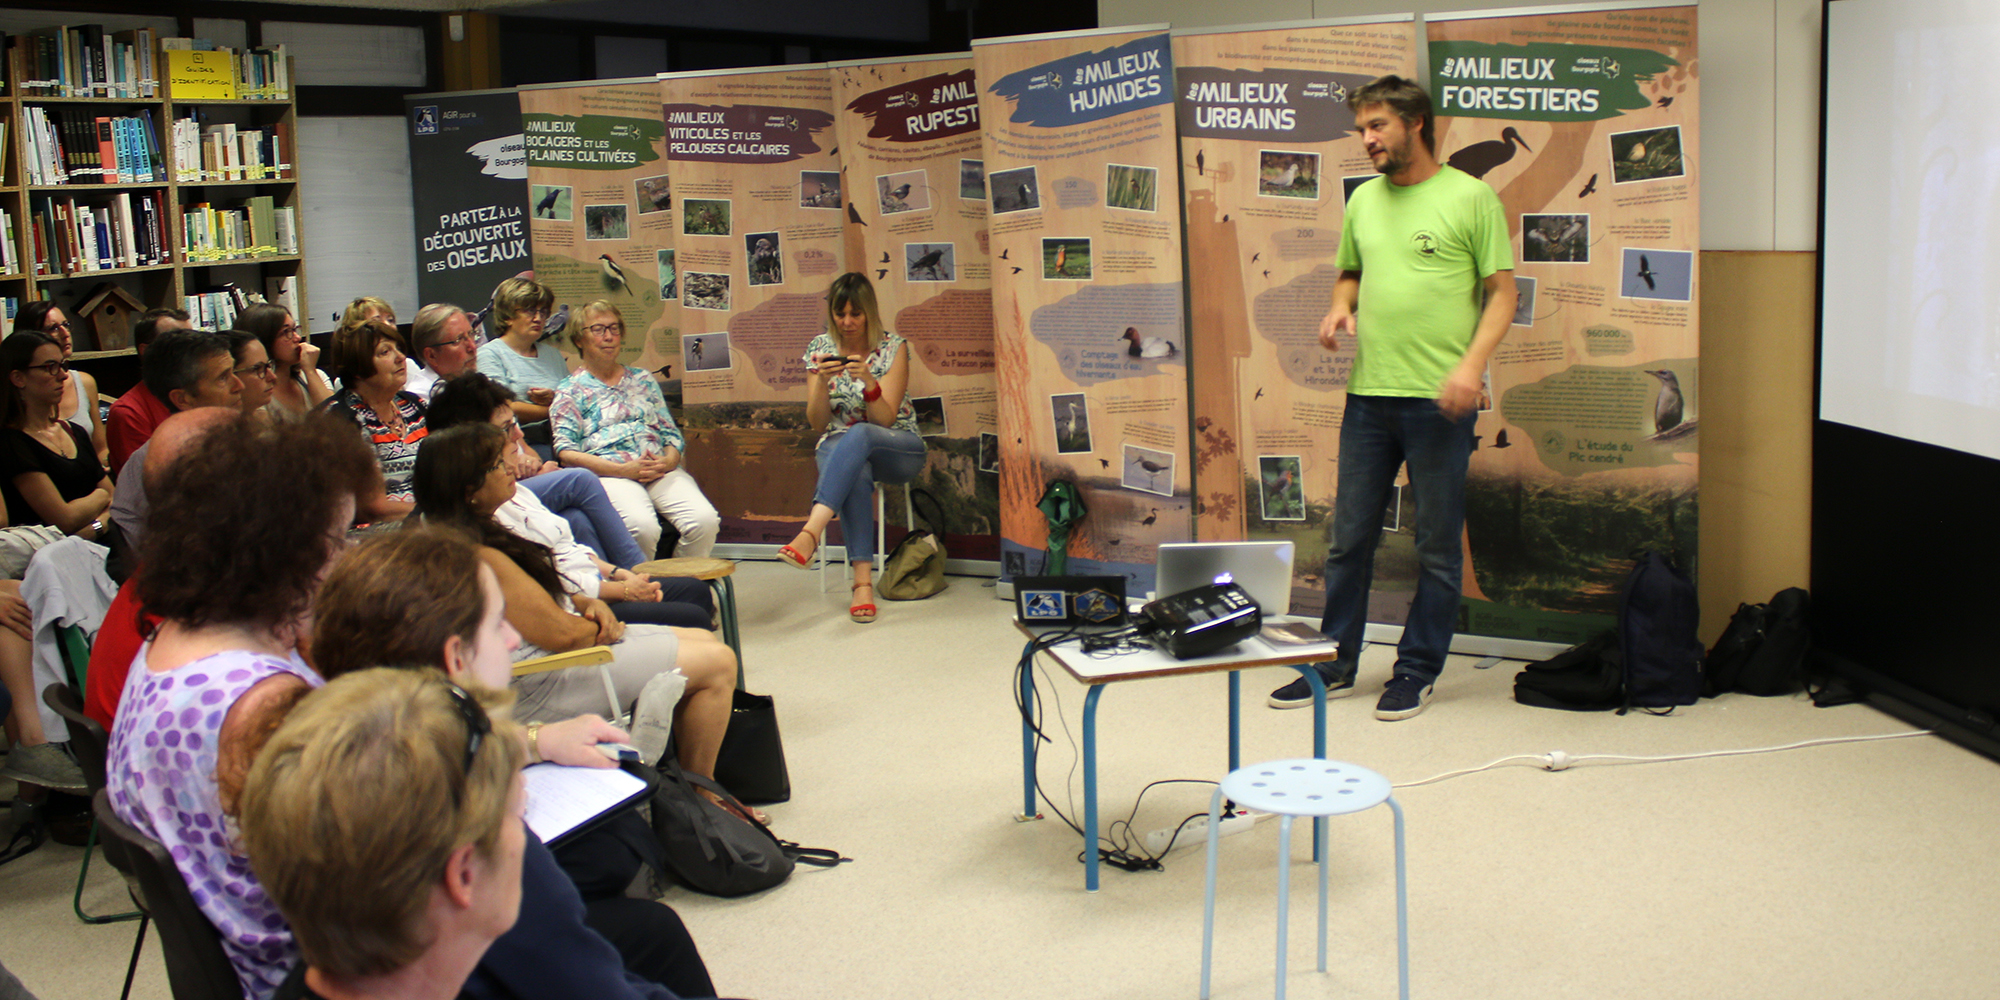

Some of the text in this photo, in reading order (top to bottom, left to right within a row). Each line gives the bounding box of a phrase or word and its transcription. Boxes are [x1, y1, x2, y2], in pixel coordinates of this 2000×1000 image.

[1072, 68, 1085, 86] les
[1084, 49, 1161, 85] MILIEUX
[1440, 57, 1556, 81] les MILIEUX
[930, 81, 978, 104] les MIL
[1069, 75, 1162, 113] HUMIDES
[1186, 82, 1288, 104] les MILIEUX
[1442, 85, 1600, 113] FORESTIERS
[442, 110, 459, 120] AGIR
[674, 112, 725, 124] MILIEUX
[906, 104, 978, 135] RUPEST
[1196, 106, 1297, 130] URBAINS
[531, 121, 576, 133] MILIEUX
[669, 127, 762, 140] VITICOLES ET LES
[500, 143, 526, 153] oiseau
[526, 135, 610, 149] BOCAGERS ET LES
[670, 143, 790, 155] PELOUSES CALCAIRES
[529, 148, 637, 163] PLAINES CULTIVÉES
[440, 205, 522, 230] PARTEZ À LA
[423, 220, 523, 252] DÉCOUVERTE
[1297, 229, 1315, 238] 200
[427, 238, 528, 273] DES OISEAUX
[1320, 354, 1332, 363] La
[1313, 366, 1325, 374] et
[1577, 438, 1634, 452] L'étude du
[1568, 451, 1625, 464] Pic cendré
